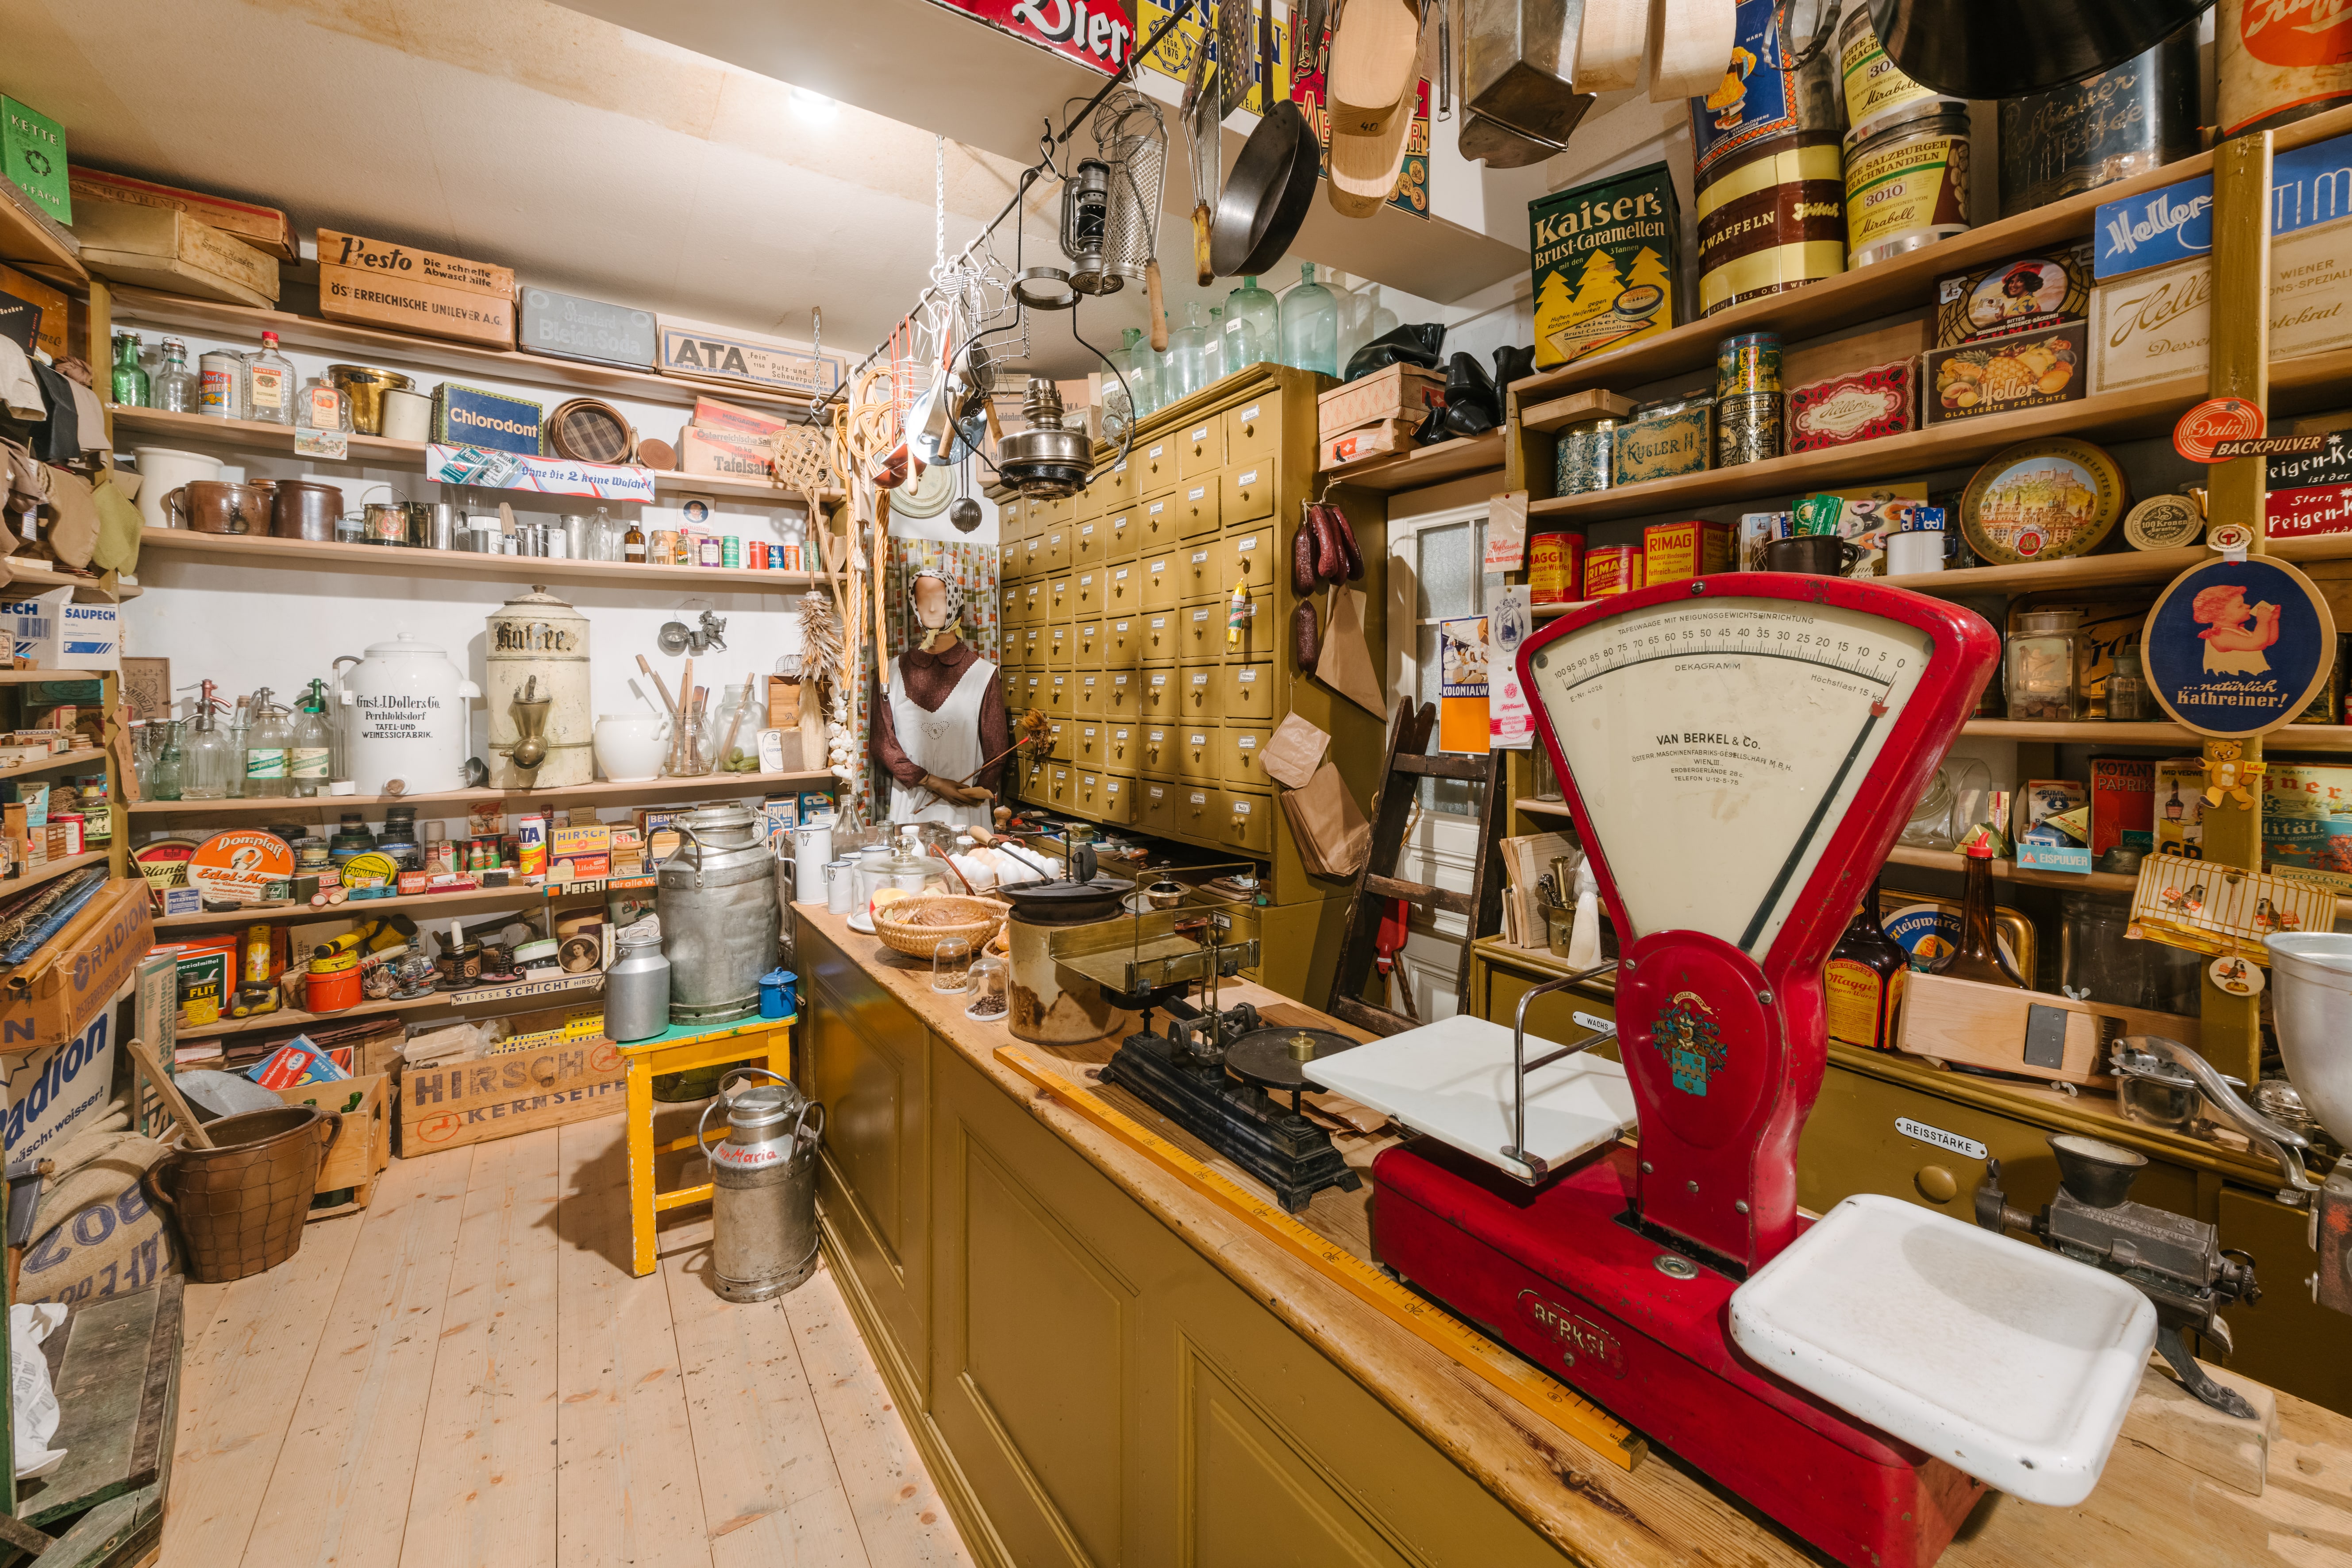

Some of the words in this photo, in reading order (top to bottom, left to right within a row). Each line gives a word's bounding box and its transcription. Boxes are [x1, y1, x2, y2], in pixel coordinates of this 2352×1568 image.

[1163, 36, 1181, 50] GEGR.
[1163, 46, 1179, 60] 1876
[12, 114, 58, 146] KETTE
[1360, 121, 1378, 132] 40
[1730, 113, 1770, 134] VERSCHLOSSENE
[1865, 140, 1948, 172] SALZBURGER
[1847, 151, 1940, 195] KRACHMANDELN
[31, 186, 60, 206] FACH
[1866, 184, 1904, 208] 3010
[1706, 211, 1775, 250] WAFFELN
[1858, 206, 1915, 237] Mirabell
[2105, 193, 2213, 259] Heller
[339, 236, 412, 271] Presto
[1534, 220, 1667, 271] Brust-Caramellen
[1614, 245, 1639, 254] Tannen
[423, 258, 441, 269] Die
[447, 264, 491, 278] schnelle
[1559, 262, 1570, 271] mit
[1571, 257, 1584, 266] den
[2280, 259, 2334, 279] WIENER
[1587, 298, 1607, 308] gegen
[431, 303, 480, 322] UNILEVER
[483, 313, 503, 326] A.G.
[564, 301, 616, 328] Standard
[2007, 316, 2025, 324] BITTER
[1547, 320, 1571, 330] Katarrh
[539, 318, 642, 356] Bleich-Soda
[674, 339, 749, 374] ATA
[253, 366, 281, 375] WAWRINA
[1974, 376, 2042, 406] Heller
[1722, 399, 1768, 415] Nürnberger
[1945, 404, 2005, 419] GLASIERTE
[2014, 394, 2067, 408] FRÜCHTE
[450, 407, 538, 438] Chlorodont
[722, 412, 761, 429] MARGARINE
[697, 429, 757, 445] Österreichische
[2216, 435, 2322, 456] BACKPULVER
[460, 447, 483, 464] Persil
[731, 451, 756, 460] feinstes
[1627, 437, 1679, 464] KUGLER
[713, 455, 772, 476] Tafelsalz
[2051, 447, 2112, 498] TORTELETTES
[521, 466, 547, 479] Ohne
[551, 468, 564, 481] die
[566, 471, 579, 482] 2
[581, 474, 609, 486] keine
[2307, 473, 2325, 483] ist
[2290, 494, 2333, 506] Stern
[1487, 539, 1523, 557] Hofbauer
[1649, 533, 1692, 553] RIMAG
[2211, 538, 2247, 551] HAMMERBROT
[1587, 557, 1629, 580] RIMAG
[1601, 568, 1628, 580] RINDSUPPE
[1648, 567, 1671, 577] fettreich
[1678, 565, 1692, 573] mild
[65, 608, 116, 621] SAUPECH
[1617, 620, 1661, 636] TAFELWAAGE
[1664, 616, 1677, 625] MIT
[1679, 612, 1814, 625] NEIGUNGSGEWICHTSEINRICHTUNG
[1554, 668, 1567, 679] 100
[1566, 663, 1577, 673] 95
[1577, 658, 1587, 668] 90
[1590, 652, 1600, 663] 85
[1603, 647, 1614, 658] 80
[1617, 643, 1628, 652] 75
[1633, 639, 1644, 648] 70
[1648, 636, 1659, 644] 65
[1664, 632, 1676, 642] 60
[1682, 630, 1694, 639] 55
[1700, 628, 1712, 638] 50
[1718, 628, 1731, 637] 45
[1737, 628, 1750, 637] 40
[1756, 628, 1770, 638] 35
[1777, 631, 1790, 641] 30
[1796, 633, 1811, 643] 25
[1815, 636, 1831, 647] 20
[1837, 641, 1850, 652] 15
[1857, 646, 1870, 657] 10
[1878, 651, 1887, 662] 5
[1896, 658, 1905, 668] 0
[1675, 663, 1741, 672] DEKAGRAMM
[1570, 691, 1586, 703] E-Nr.
[1587, 684, 1603, 695] 4026
[1811, 673, 1857, 692] Höchstlast
[1859, 687, 1869, 697] 15
[1871, 691, 1884, 704] kg
[2200, 679, 2277, 692] natürlich
[1500, 703, 1525, 712] Hofbauer
[2176, 690, 2288, 708] Kathreiner!
[365, 711, 426, 720] Perchtoldsdorf
[1656, 733, 1678, 746] VAN
[1683, 732, 1729, 745] BERKEL
[1732, 736, 1739, 746] &
[1743, 735, 1761, 750] Co.
[1671, 767, 1727, 776] ERDBERGERLÄNDE
[1769, 759, 1794, 772] M.B.H.
[1706, 776, 1739, 786] U-12-5-75
[768, 805, 793, 818] EMPOR
[558, 828, 607, 841] HIRSCH
[616, 834, 632, 843] Sil
[216, 836, 285, 861] Dompfaff
[2039, 852, 2088, 867] EISPULVER
[212, 887, 255, 895] Dompfaff-Politur
[562, 879, 606, 896] Persil
[611, 880, 624, 889] für
[624, 878, 643, 888] alle
[89, 896, 149, 975] RADION
[189, 984, 216, 998] FLIT
[454, 990, 501, 1002] WEISSE
[505, 980, 569, 998] SCHICHT
[1827, 984, 1852, 994] Suppen
[1853, 990, 1878, 1001] Würze
[158, 975, 167, 1064] Selbsttätiges
[166, 972, 174, 1061] Waschmittel
[1586, 1017, 1609, 1030] WACHS
[490, 1042, 547, 1055] HIRSCH
[502, 1036, 559, 1049] Hirsch
[262, 1048, 292, 1086] Sonderangebot
[415, 1049, 585, 1107] HIRSCH
[54, 1085, 103, 1133] weisser!
[467, 1080, 626, 1125] KERNSEIFE
[1905, 1122, 1972, 1152] REISSTÄRKE
